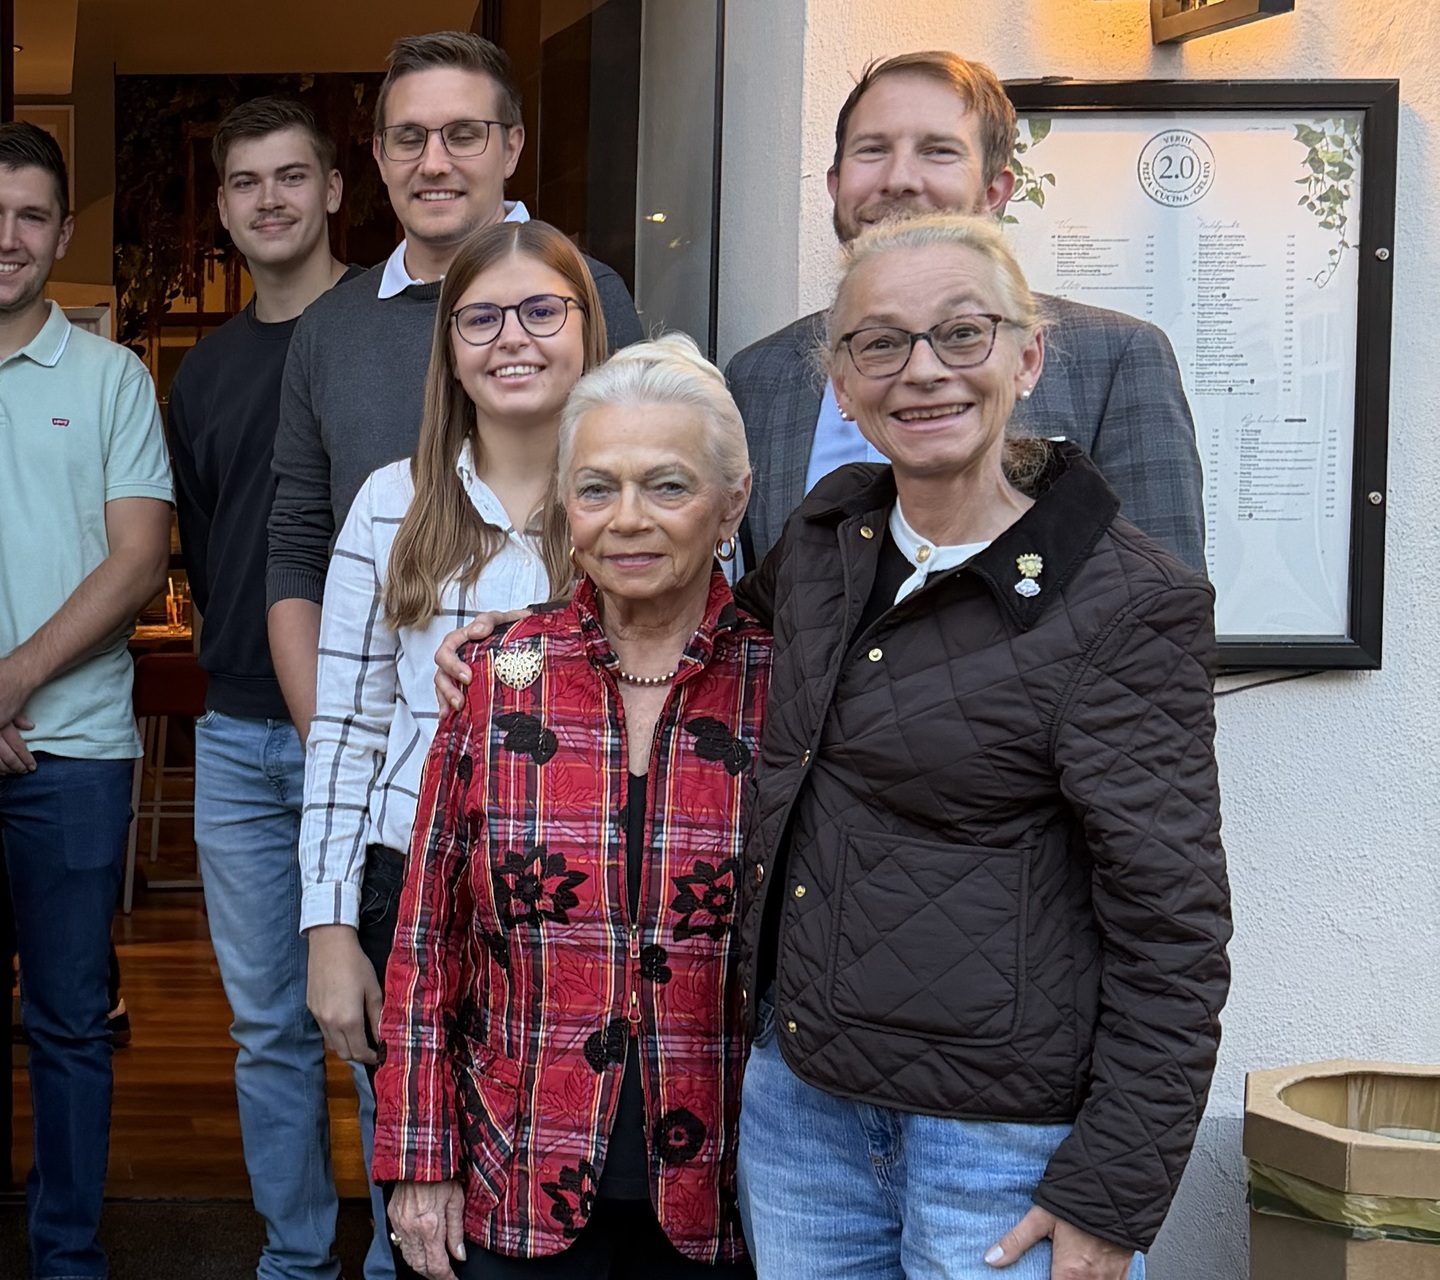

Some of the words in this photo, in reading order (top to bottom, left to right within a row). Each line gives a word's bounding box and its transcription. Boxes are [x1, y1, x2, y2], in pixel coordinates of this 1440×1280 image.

[1162, 135, 1192, 146] VERDI
[1158, 155, 1195, 180] 2.0
[1142, 161, 1153, 188] PIZZA
[1154, 189, 1189, 203] CUCINA
[1193, 161, 1210, 195] GELATO
